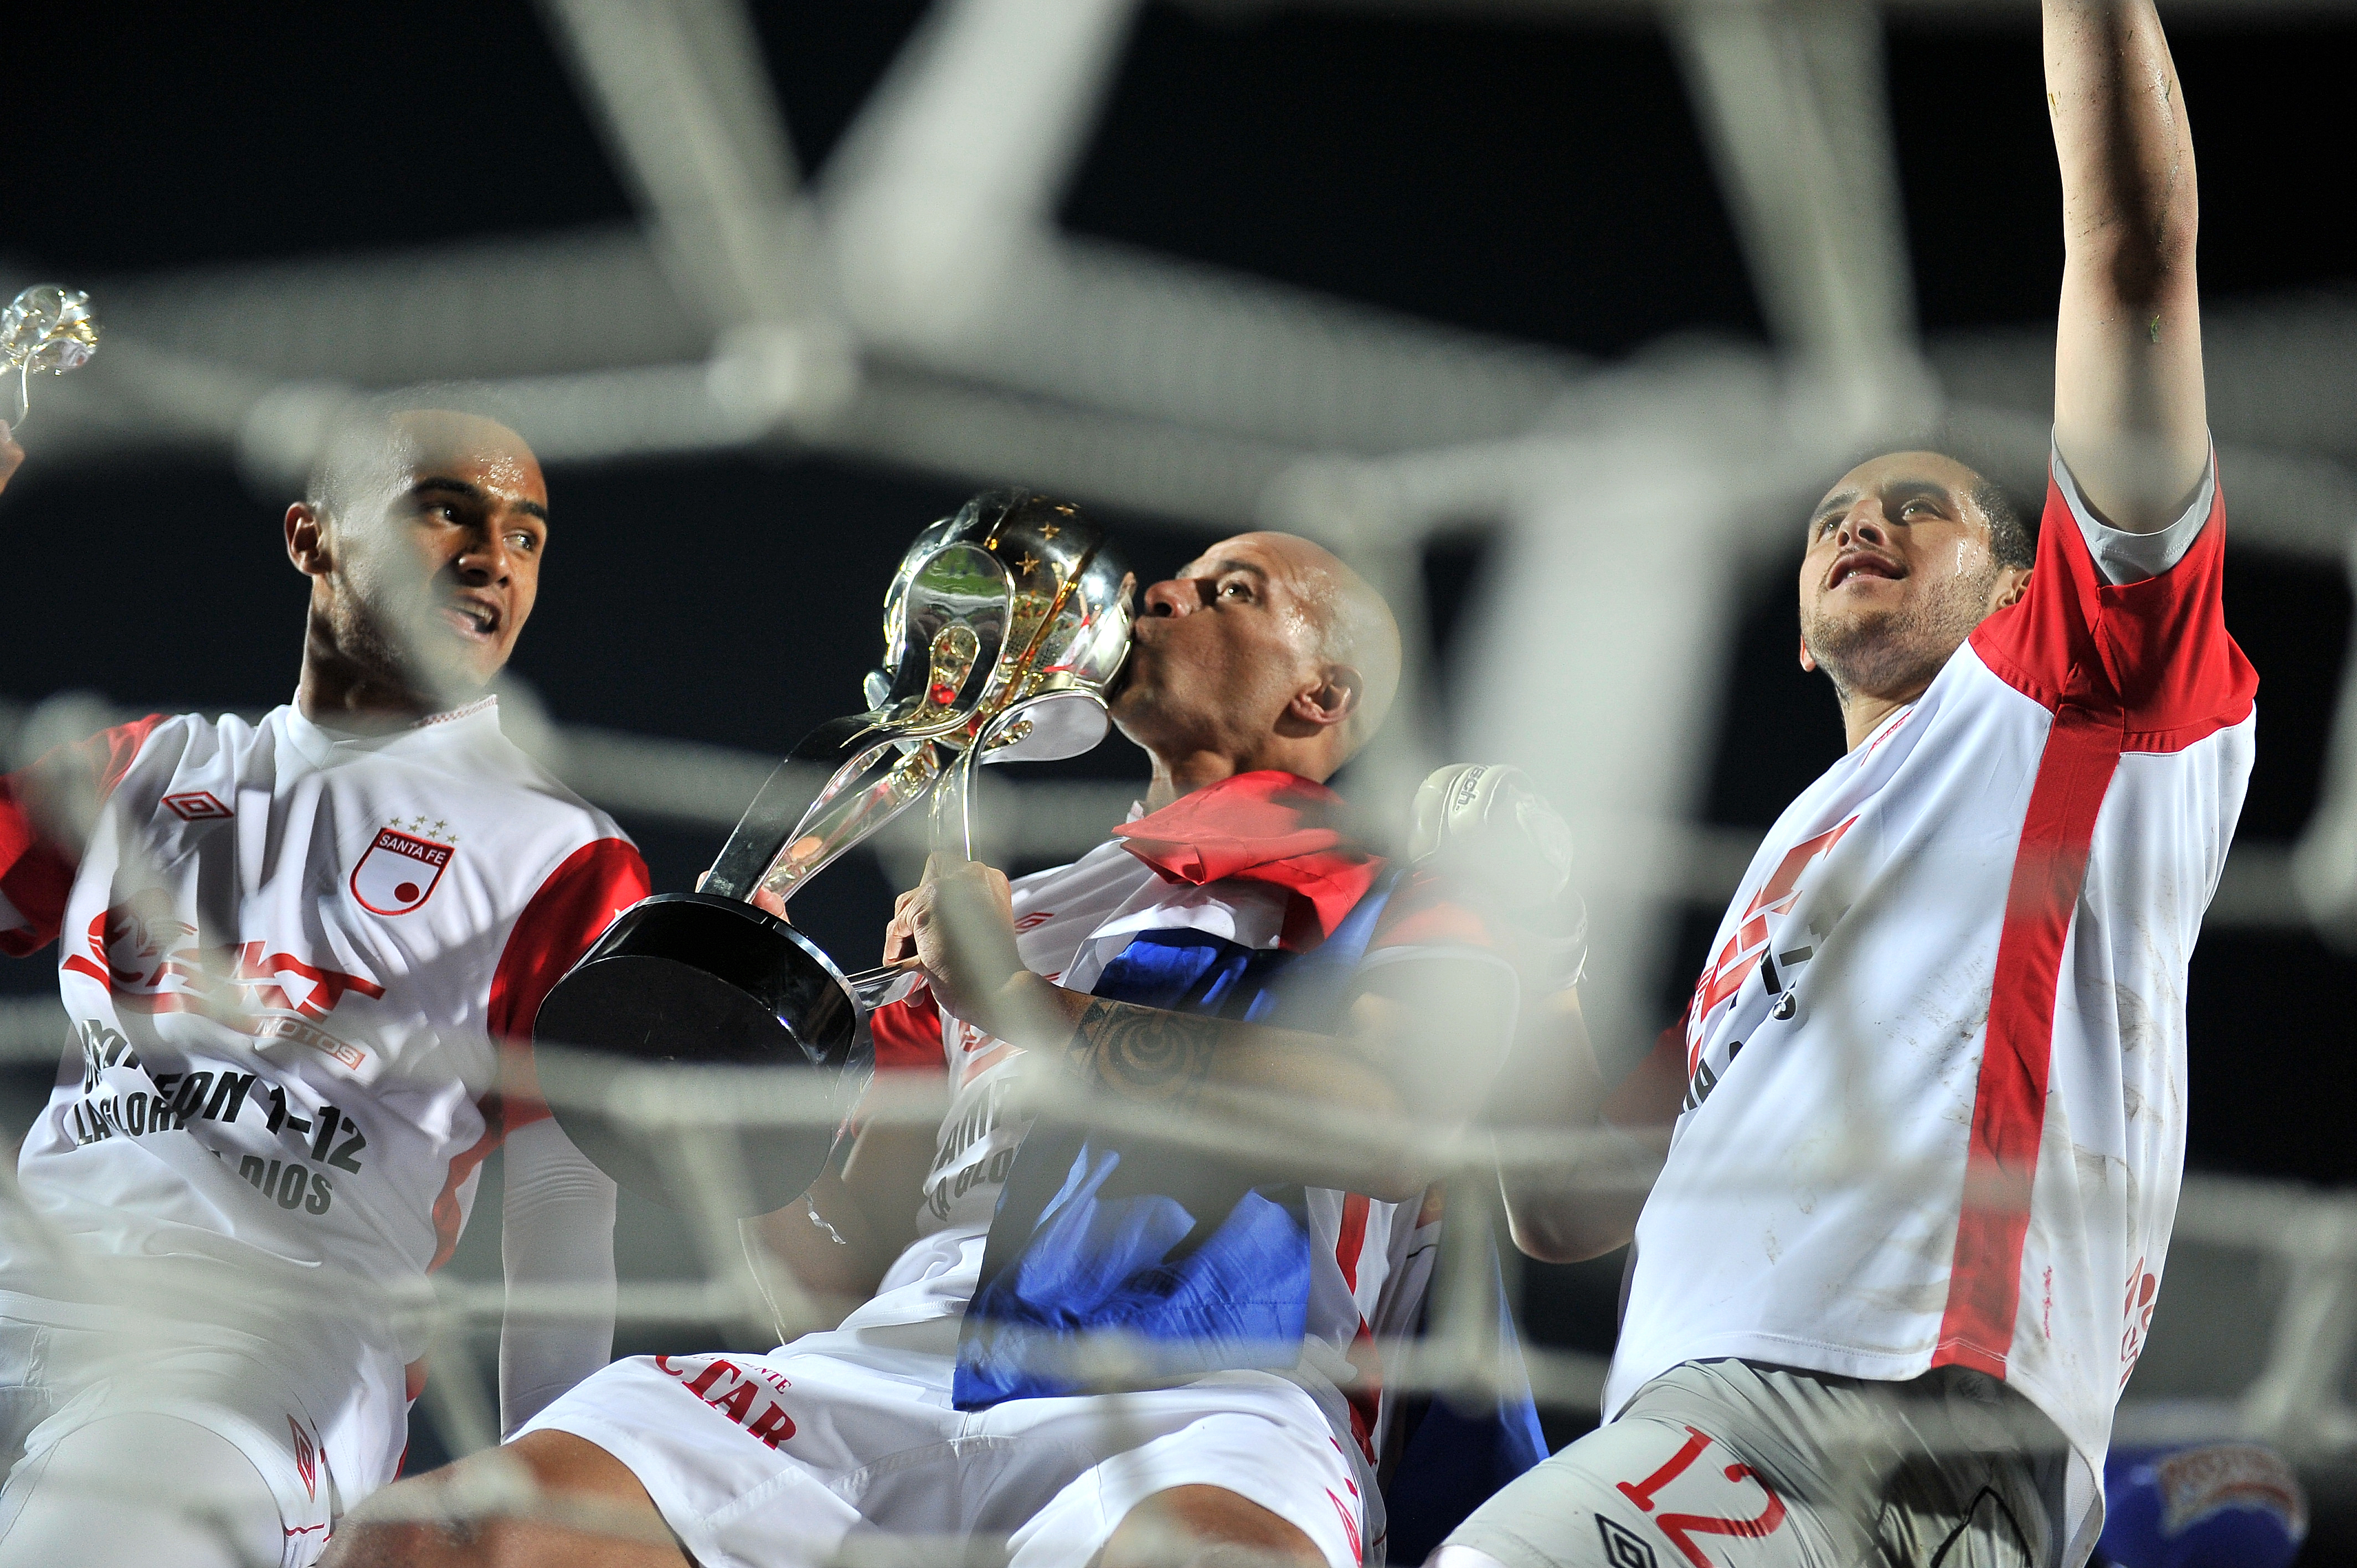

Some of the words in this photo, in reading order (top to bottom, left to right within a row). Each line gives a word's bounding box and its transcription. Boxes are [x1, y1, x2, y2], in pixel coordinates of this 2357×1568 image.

[379, 834, 425, 859] SANTA
[425, 849, 446, 865] FE
[254, 1018, 359, 1065] MOTOS
[265, 1085, 367, 1174] 1-12
[1616, 1425, 1787, 1568] 12
